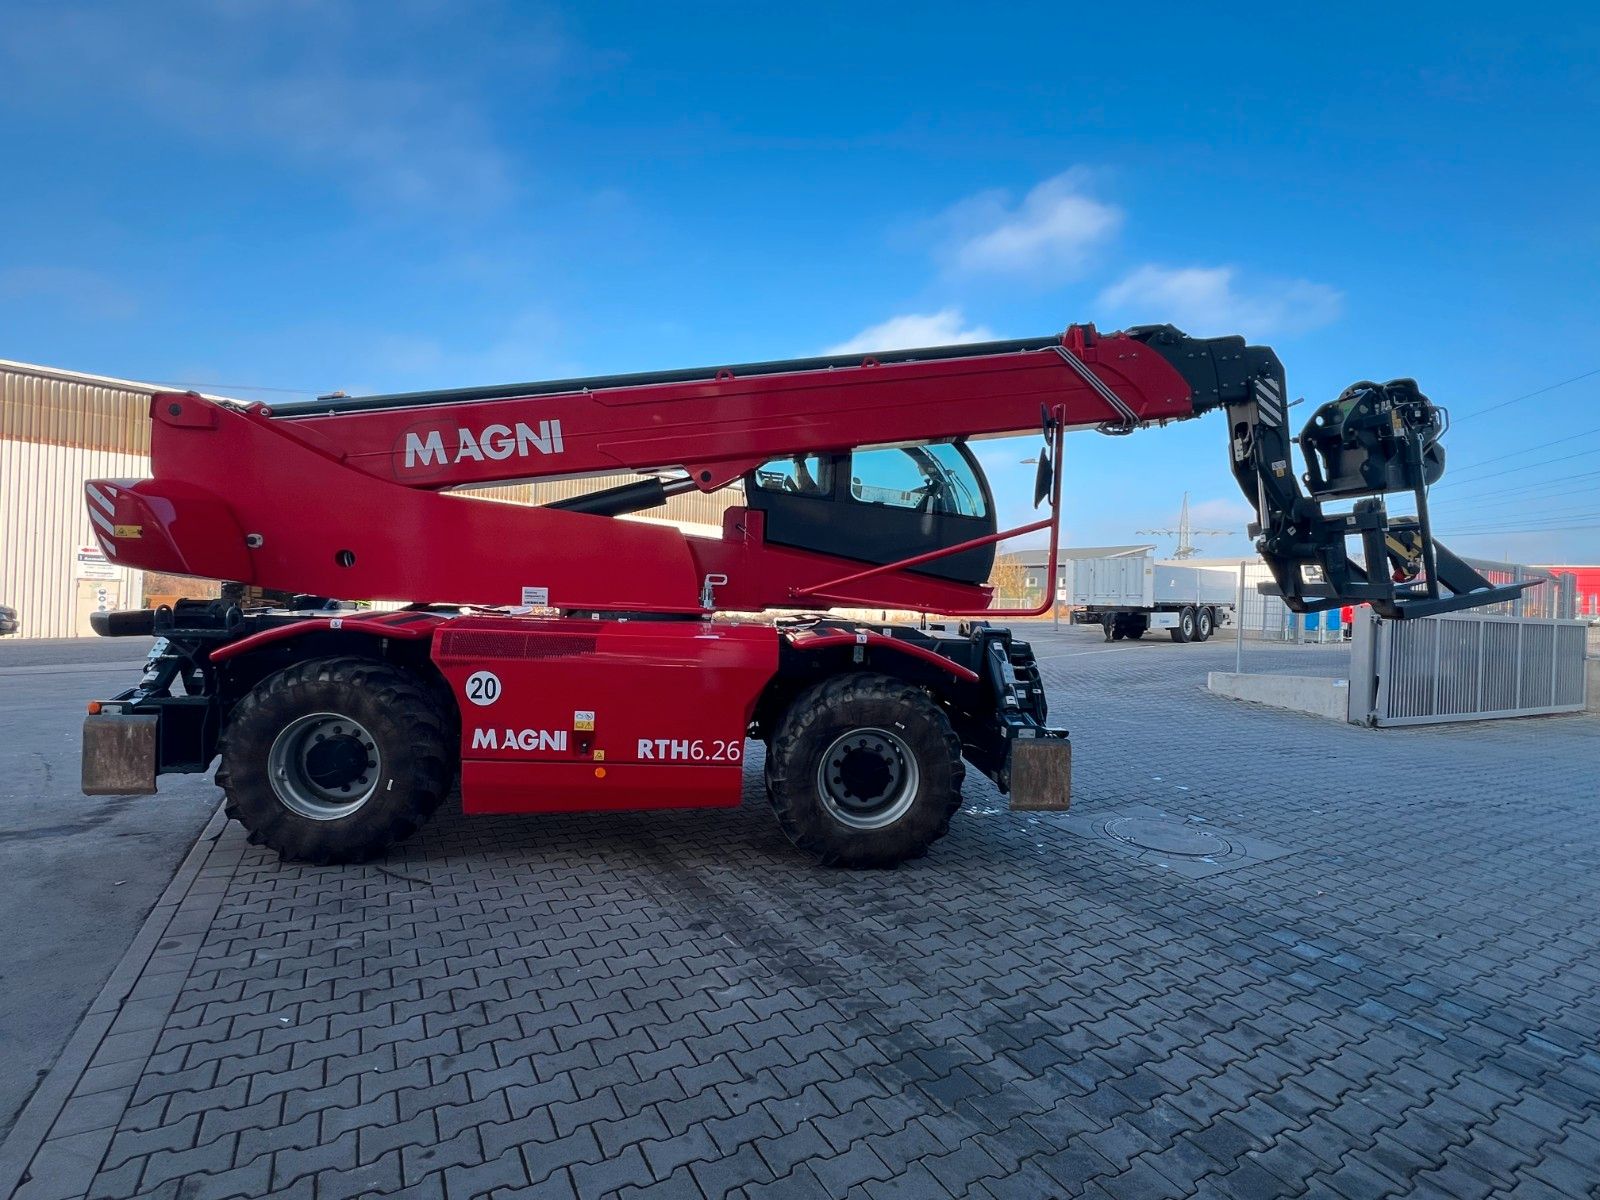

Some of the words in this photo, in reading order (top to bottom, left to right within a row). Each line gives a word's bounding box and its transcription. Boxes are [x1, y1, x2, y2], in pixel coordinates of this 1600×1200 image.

[405, 419, 564, 468] MAGNI
[470, 677, 497, 700] 20
[472, 728, 568, 751] MAGNI
[637, 738, 741, 761] RTH6.26
